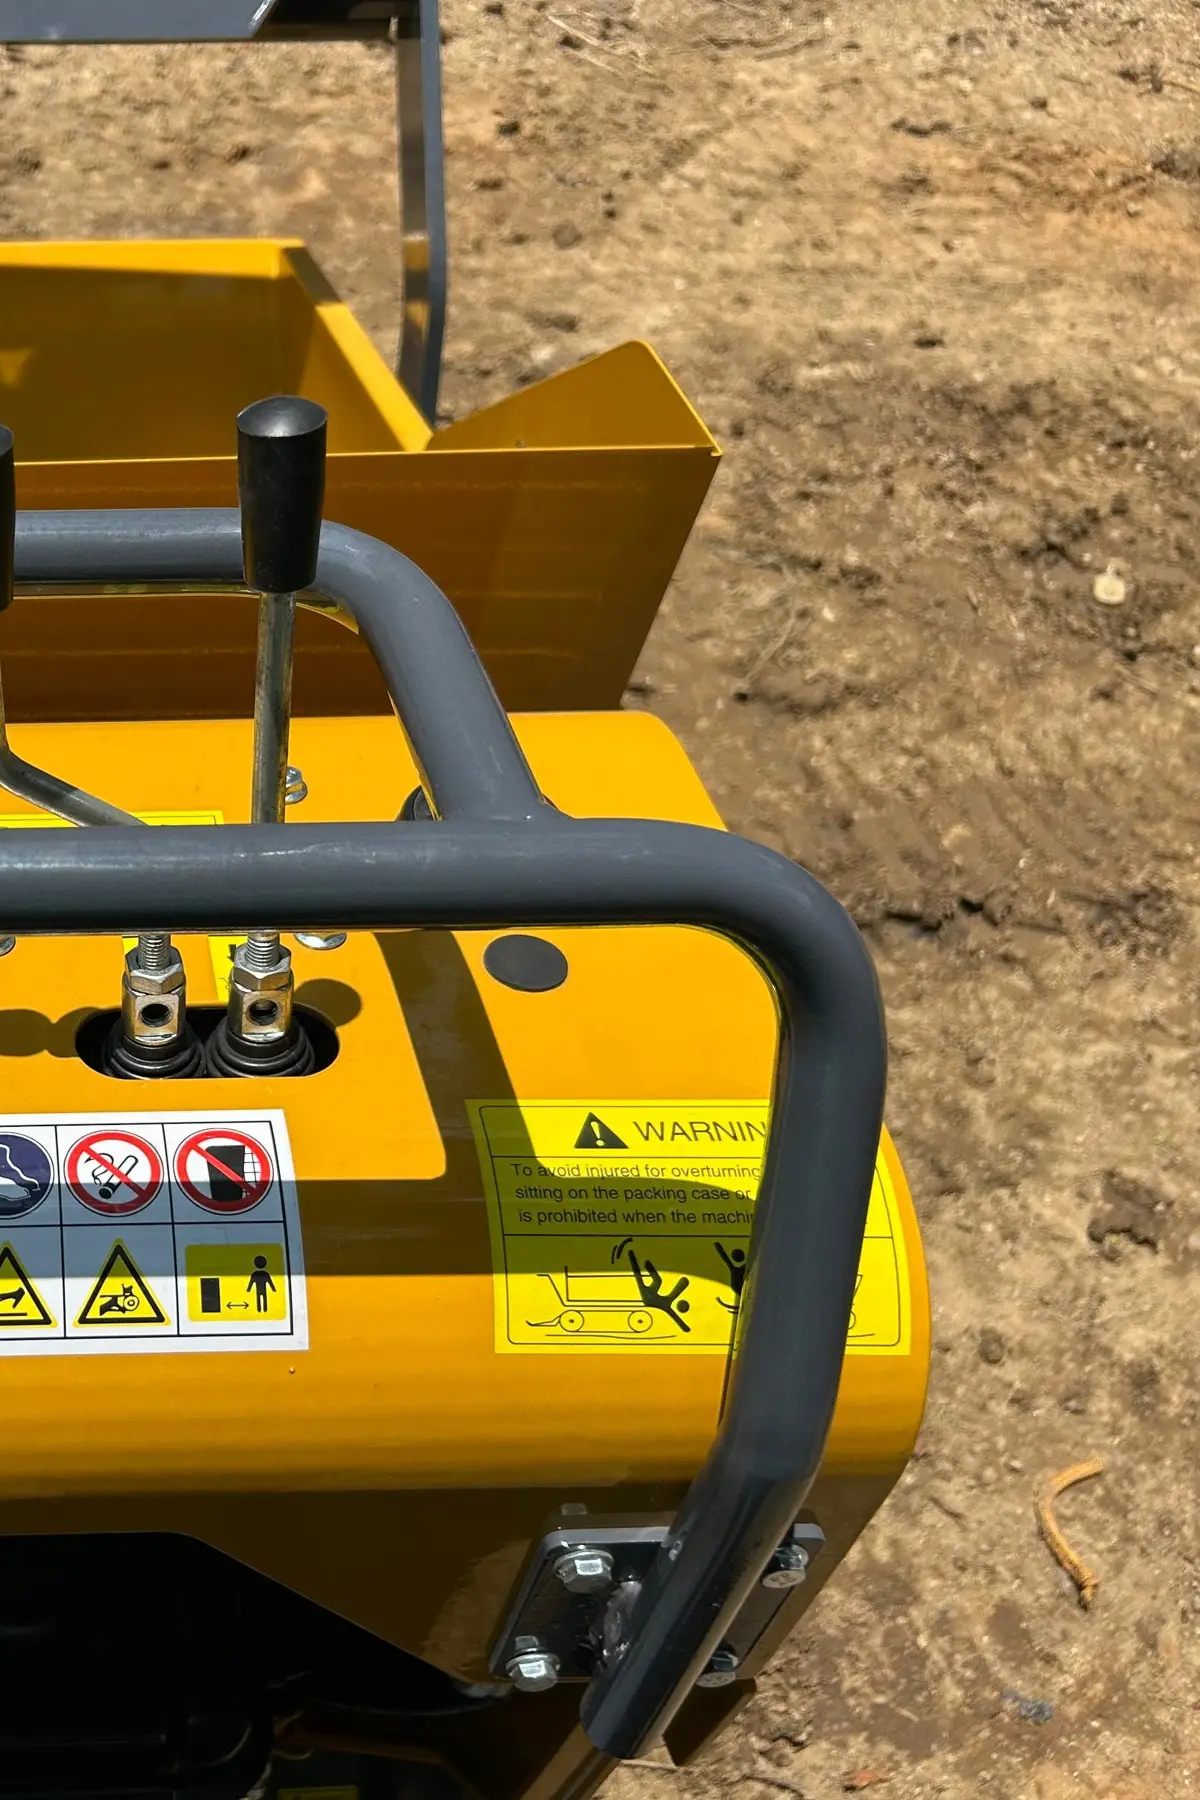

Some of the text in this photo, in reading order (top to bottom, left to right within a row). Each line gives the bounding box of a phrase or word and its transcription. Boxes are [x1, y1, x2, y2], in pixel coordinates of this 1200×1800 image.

[633, 1120, 766, 1142] WARNIN
[511, 1163, 531, 1177] To
[537, 1164, 580, 1178] avoid
[586, 1164, 640, 1180] injured
[644, 1164, 666, 1178] for
[515, 1186, 751, 1203] sitting on the packing case or
[519, 1209, 532, 1223] is
[538, 1209, 617, 1226] prohibited
[622, 1210, 665, 1223] when
[671, 1209, 696, 1223] the
